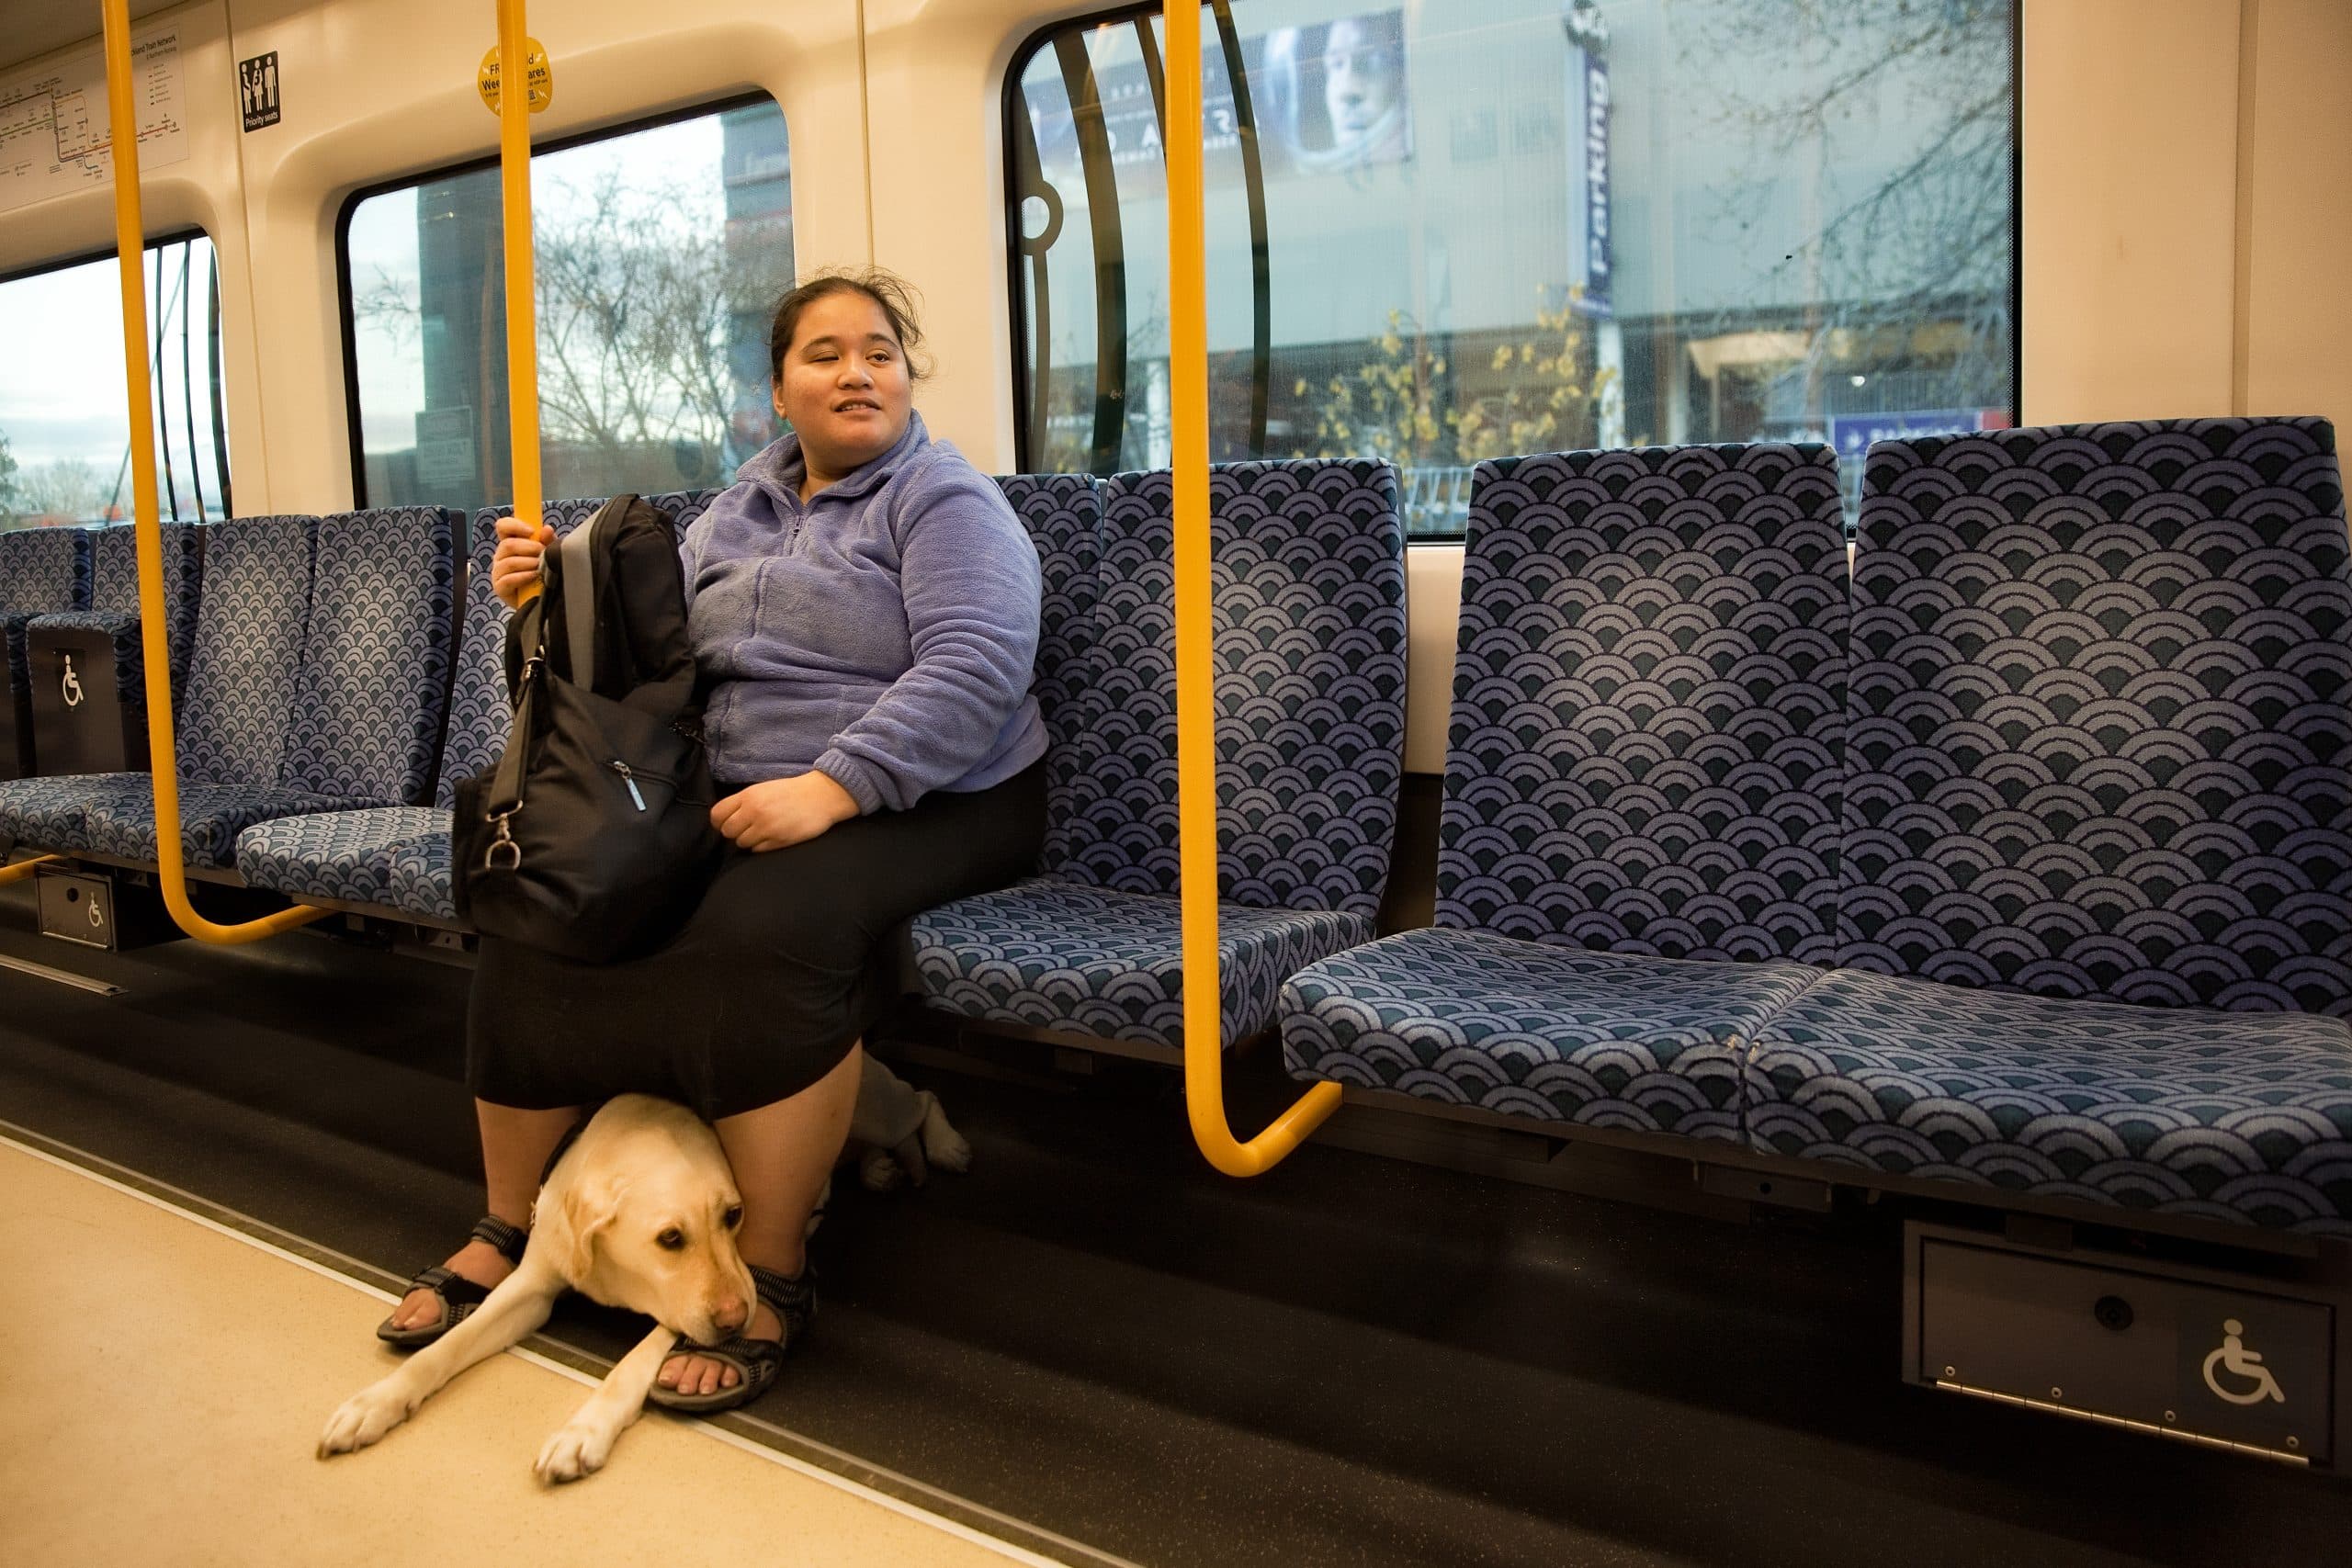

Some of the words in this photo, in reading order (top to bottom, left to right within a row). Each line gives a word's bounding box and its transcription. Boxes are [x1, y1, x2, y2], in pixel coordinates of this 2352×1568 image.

[490, 62, 500, 75] FR
[528, 67, 545, 80] ares
[245, 115, 264, 127] Priority
[265, 111, 278, 122] seats
